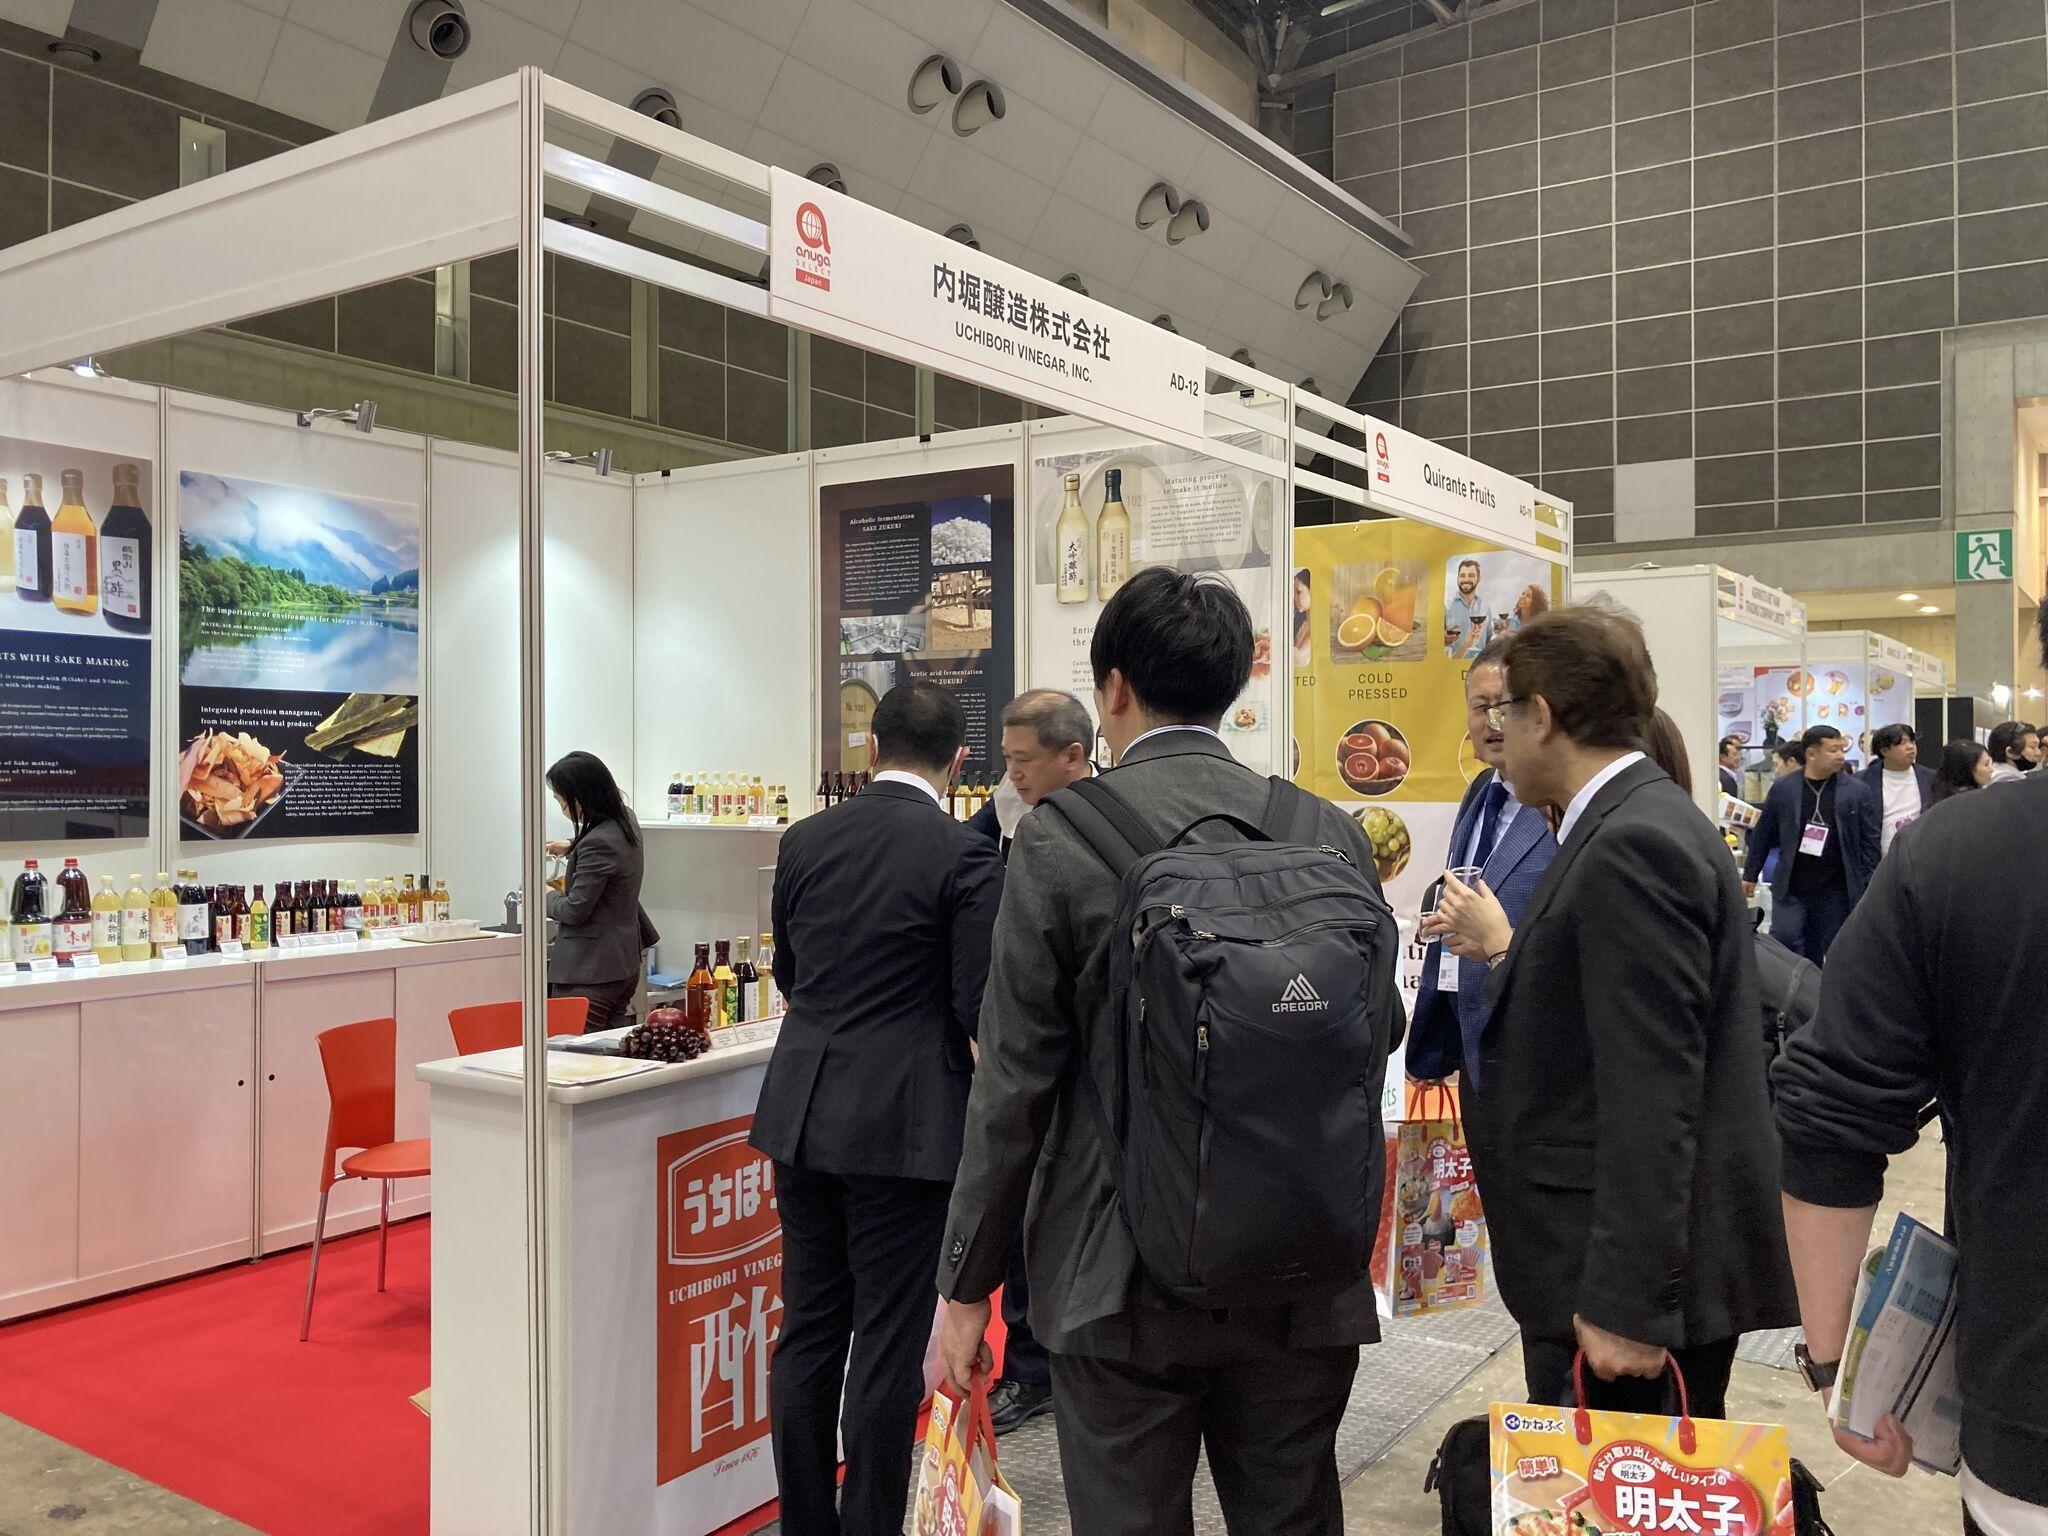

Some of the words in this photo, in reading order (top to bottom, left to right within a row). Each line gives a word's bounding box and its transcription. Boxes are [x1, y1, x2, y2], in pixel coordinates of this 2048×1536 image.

[796, 246, 830, 267] anuga
[796, 259, 831, 277] SELECT
[804, 274, 822, 287] Japan
[933, 262, 1111, 362] 内堀醸造株式会社
[955, 320, 1014, 356] UCHIBORI
[1017, 343, 1069, 377] VINEGAR,
[1072, 363, 1092, 383] INC.
[1170, 372, 1198, 397] AD-12
[1165, 475, 1197, 485] Maturing
[1200, 472, 1227, 482] process
[1173, 486, 1191, 494] make
[1201, 482, 1228, 490] mellow
[1423, 463, 1467, 498] Quirante
[1469, 481, 1496, 509] Fruits
[201, 605, 216, 614] The
[217, 607, 260, 619] importance
[262, 610, 271, 618] of
[272, 612, 317, 622] environment
[319, 615, 330, 623] for
[331, 617, 357, 626] vinegar
[359, 619, 384, 629] making
[1072, 638, 1087, 646] the
[20, 653, 50, 663] WITH
[54, 655, 82, 665] SAKE
[86, 657, 129, 667] MAKING
[910, 670, 928, 678] Acetic
[1358, 672, 1393, 684] COLD
[1348, 687, 1407, 700] PRESSED
[201, 706, 238, 714] Integrated
[240, 707, 277, 715] production
[278, 709, 323, 717] management,
[219, 718, 259, 727] ingredients
[270, 719, 285, 727] final
[1271, 1000, 1329, 1013] GREGORY
[1433, 1157, 1473, 1179] 明太子
[668, 1268, 737, 1305] UCHIBORI
[688, 1286, 784, 1453] 酢
[1521, 1418, 1564, 1432] かねふく
[713, 1457, 739, 1477] Since
[1620, 1471, 1648, 1481] 明太子
[1615, 1485, 1746, 1536] 明太子
